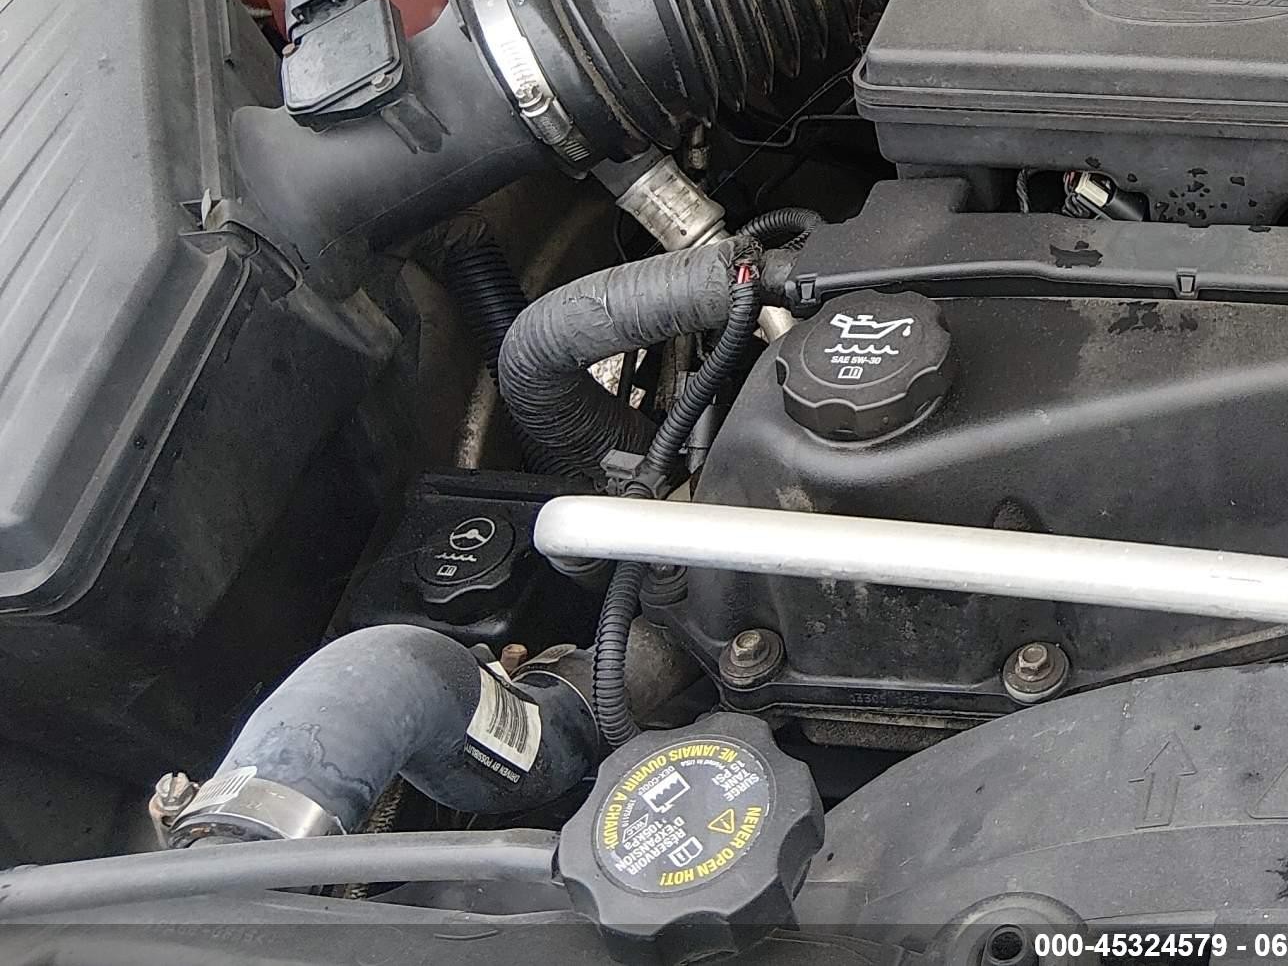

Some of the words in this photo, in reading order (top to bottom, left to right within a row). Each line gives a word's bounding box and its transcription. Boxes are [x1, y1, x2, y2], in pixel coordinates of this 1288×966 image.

[830, 355, 851, 364] SAE
[850, 355, 882, 365] 5W-30
[669, 744, 720, 762] JAMAIS
[718, 746, 739, 763] NE
[730, 760, 746, 772] 15
[622, 754, 668, 792] OUVRIR
[711, 767, 733, 786] PSI
[719, 766, 752, 793] TANK
[723, 773, 760, 802] SURGE
[730, 806, 762, 849] NEVER
[615, 816, 685, 872] D'EXPANSION
[626, 828, 687, 876] RÉSERVOIR
[696, 848, 735, 878] OPEN
[659, 868, 695, 887] HOT!
